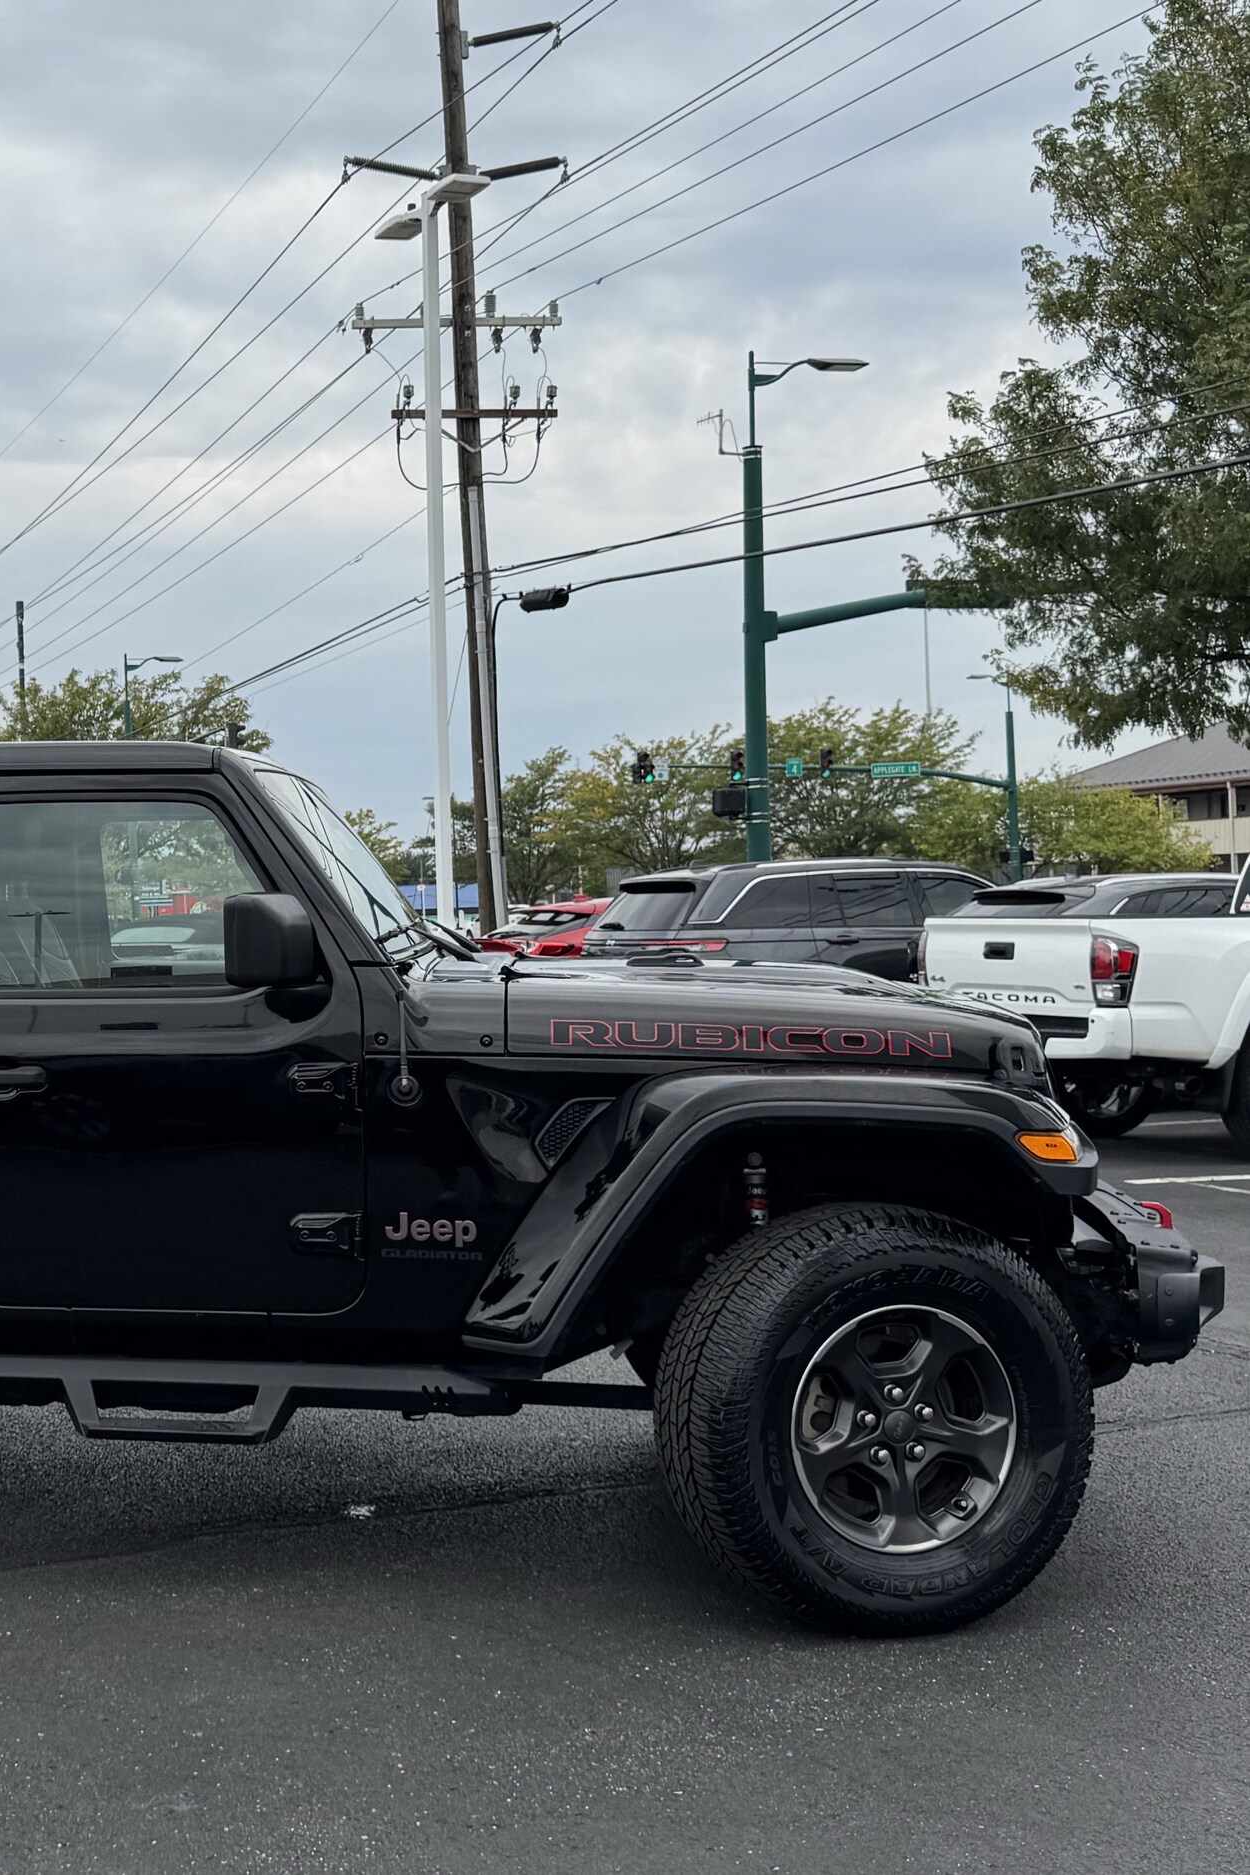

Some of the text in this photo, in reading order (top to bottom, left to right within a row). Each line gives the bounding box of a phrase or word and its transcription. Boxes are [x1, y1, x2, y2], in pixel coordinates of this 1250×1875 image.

[873, 764, 906, 774] APPLEGATE
[549, 1018, 953, 1059] RUBICON
[384, 1211, 478, 1249] Jeep
[380, 1248, 484, 1262] GLADIATOR
